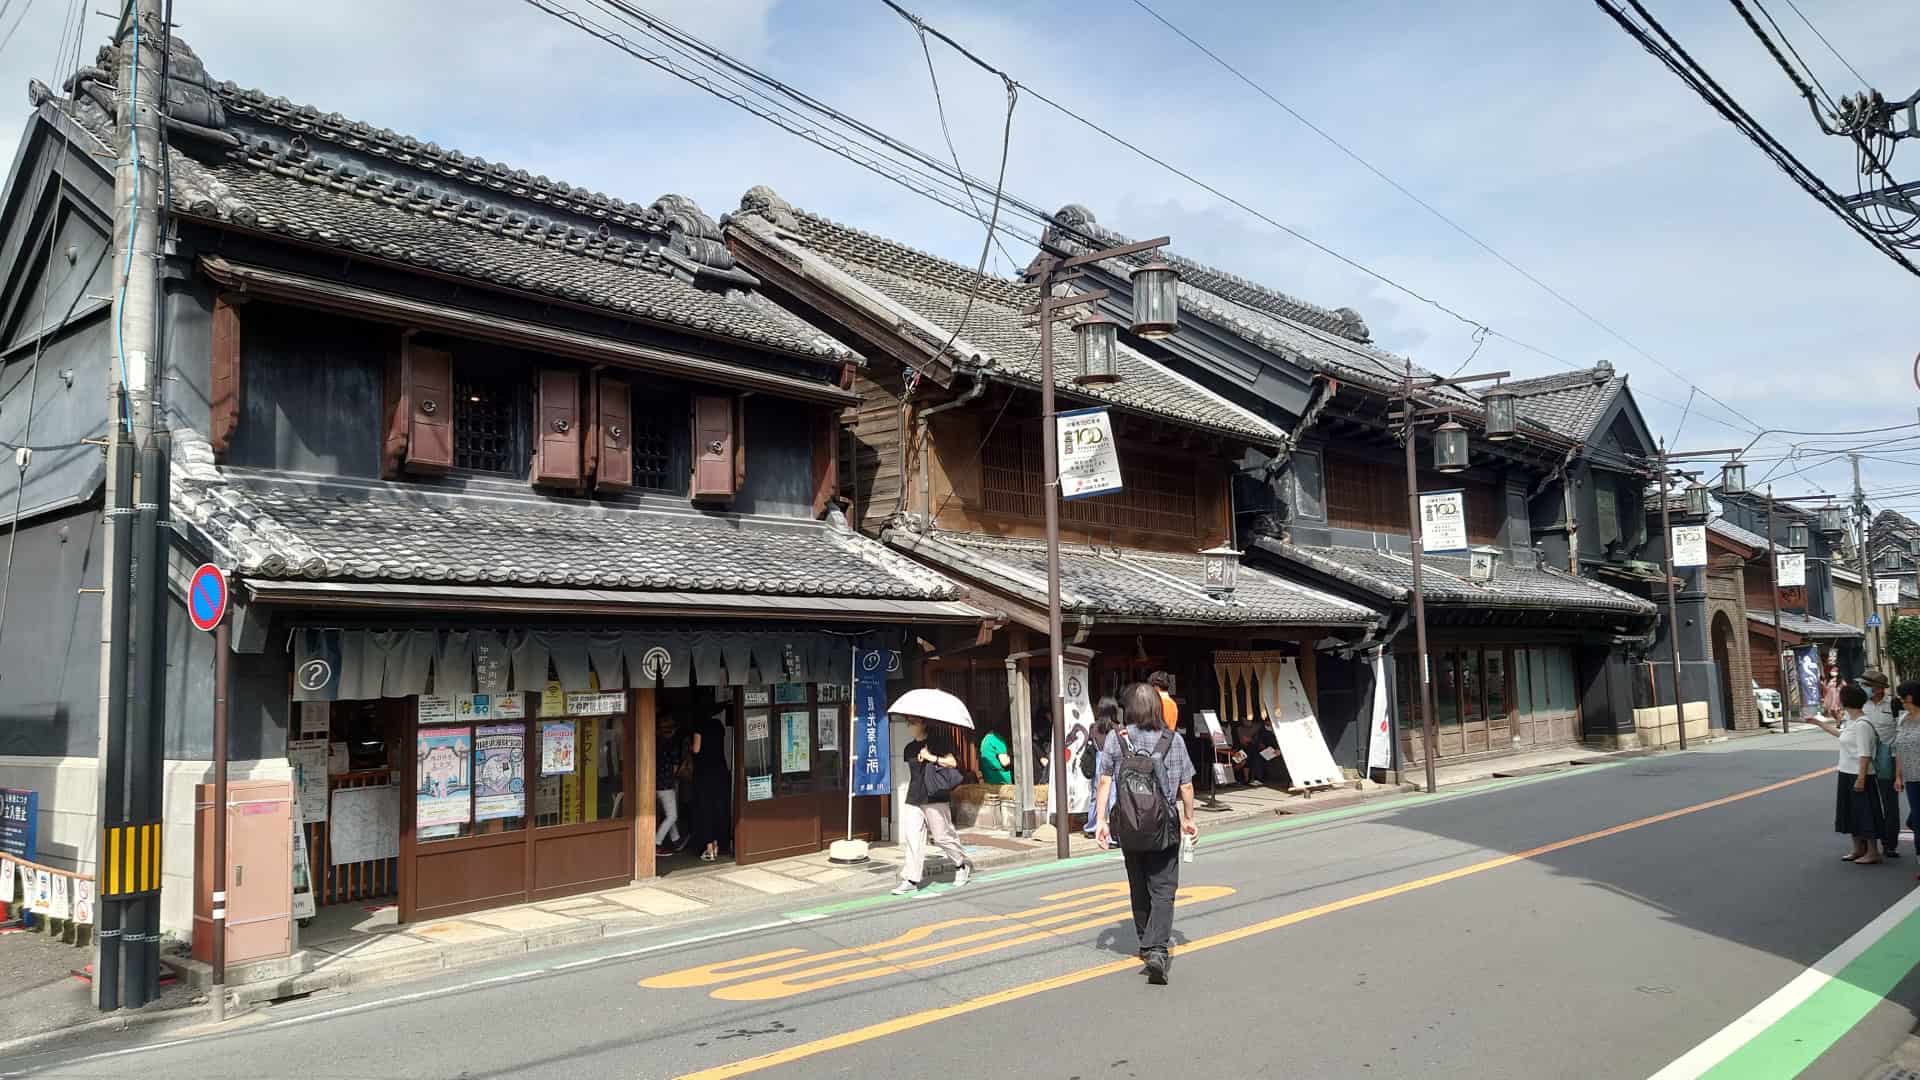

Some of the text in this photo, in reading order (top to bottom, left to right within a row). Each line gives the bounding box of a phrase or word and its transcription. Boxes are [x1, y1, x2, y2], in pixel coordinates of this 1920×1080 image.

[748, 720, 767, 732] OPEN
[3, 803, 28, 821] 立入禁止
